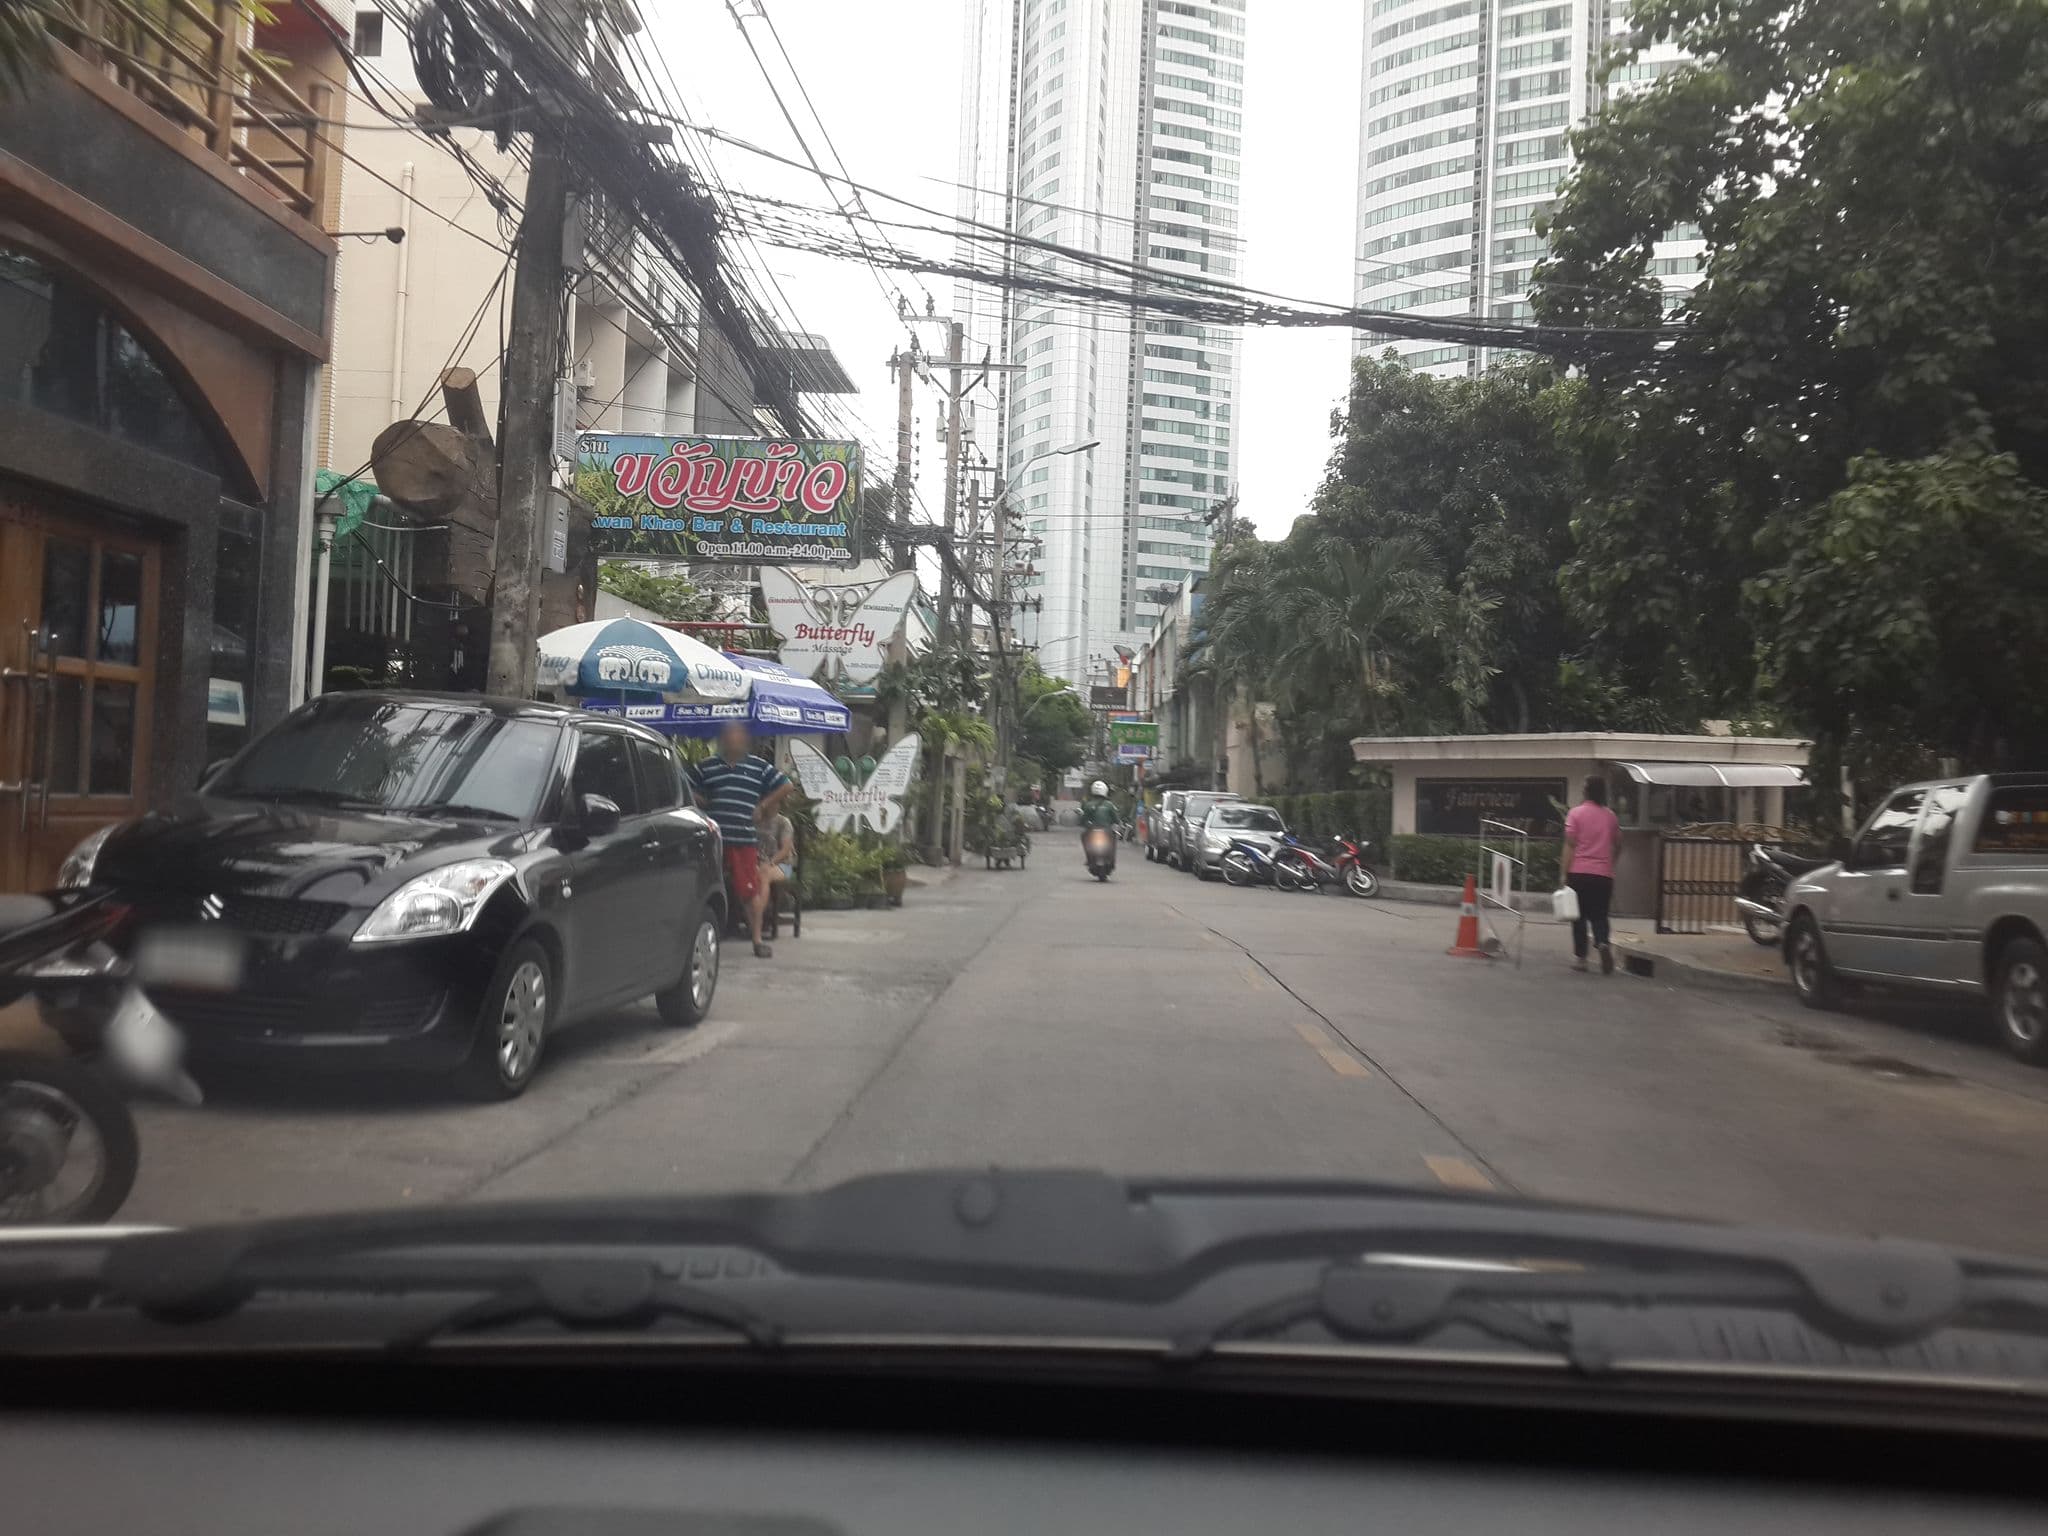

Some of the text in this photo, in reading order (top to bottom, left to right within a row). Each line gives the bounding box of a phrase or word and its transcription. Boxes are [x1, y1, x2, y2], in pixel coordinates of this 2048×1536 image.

[580, 437, 608, 454] ร้าน
[613, 441, 847, 514] ขวัญข้าว
[641, 515, 685, 532] Khao
[692, 517, 723, 533] Bar
[730, 518, 744, 534] &
[751, 518, 847, 537] Restaurant
[697, 540, 729, 556] Open
[731, 541, 763, 556] 11.00
[795, 622, 875, 647] Butterfly
[812, 643, 853, 657] Massage
[695, 663, 742, 688] Chang
[629, 707, 661, 716] LIGHT
[714, 706, 745, 715] LIGHT
[823, 785, 887, 808] Butterfly
